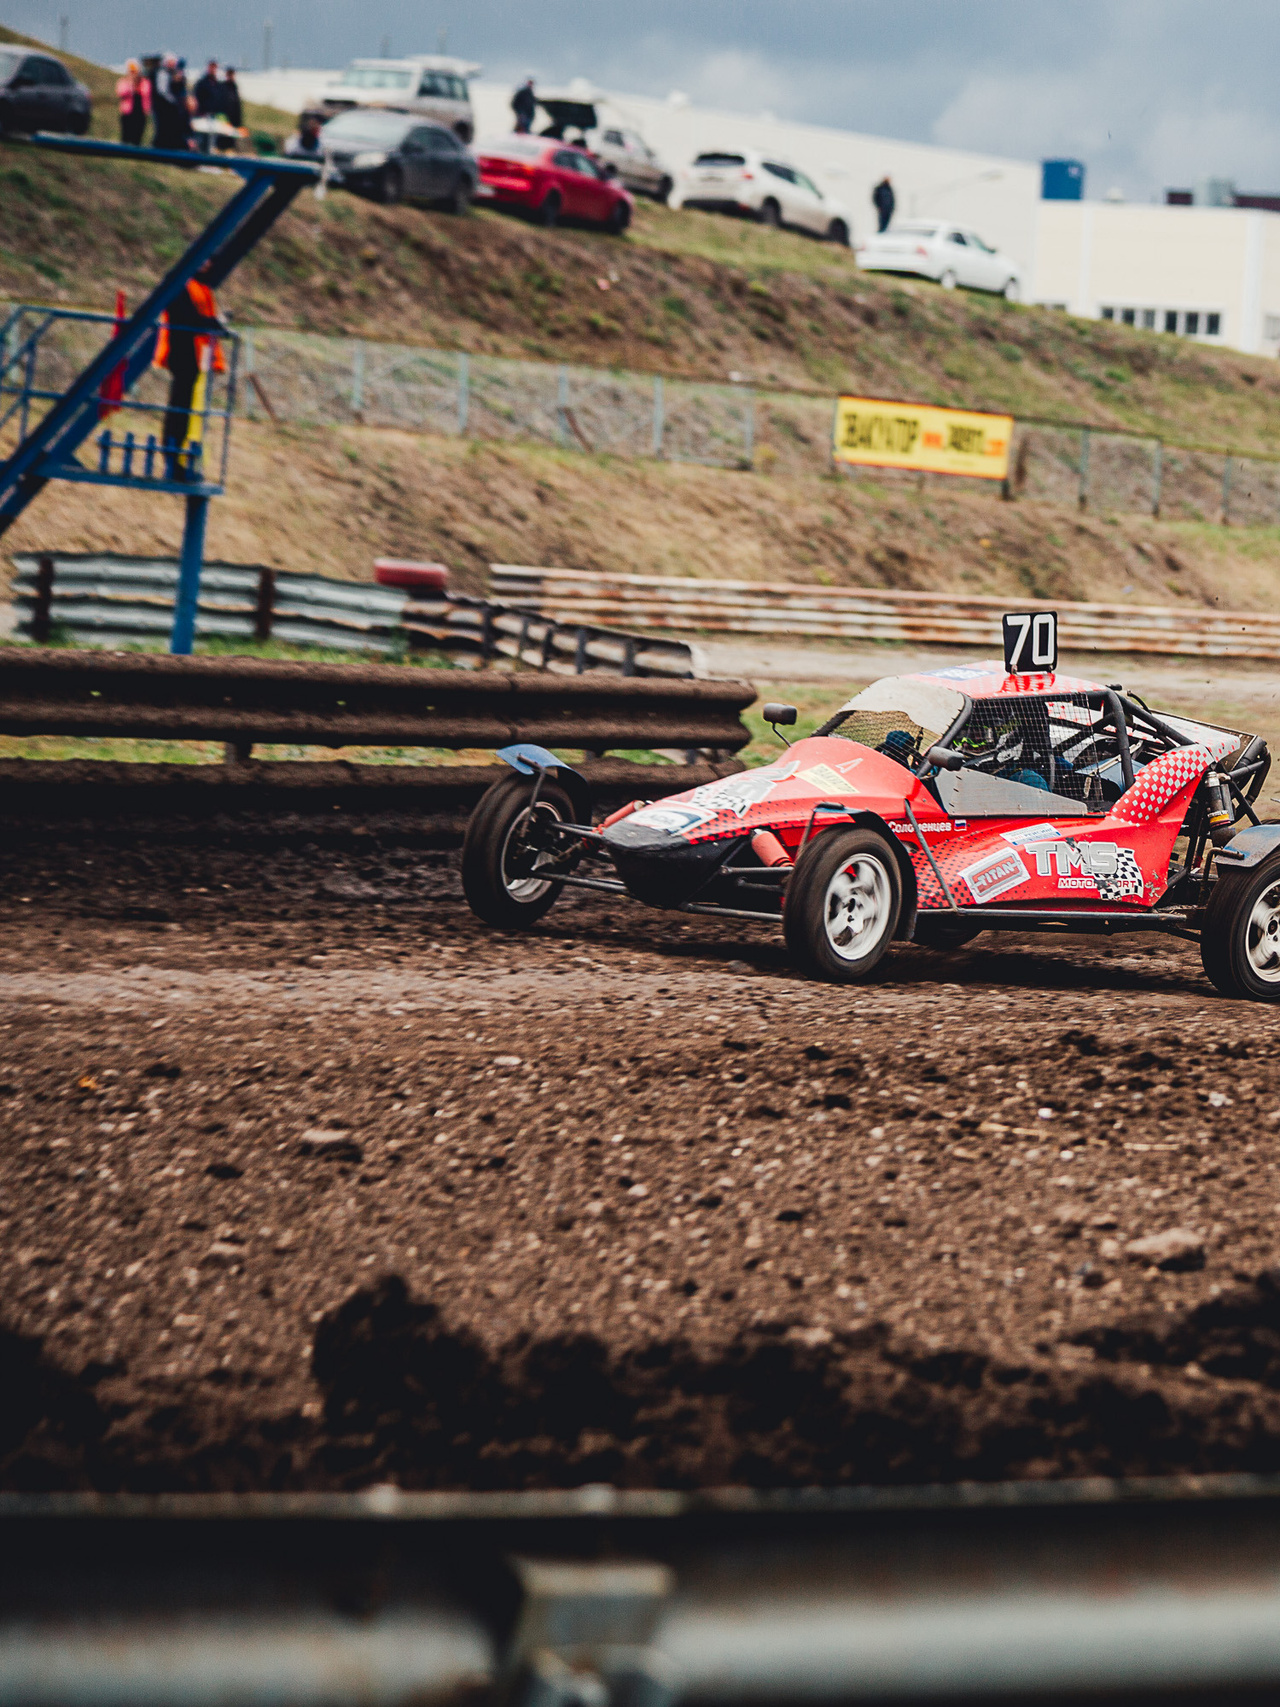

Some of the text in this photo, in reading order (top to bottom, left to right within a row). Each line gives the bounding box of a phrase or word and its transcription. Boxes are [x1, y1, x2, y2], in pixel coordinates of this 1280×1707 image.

[1006, 613, 1055, 666] 70
[977, 861, 1015, 886] TITAN
[1024, 841, 1118, 876] TMS
